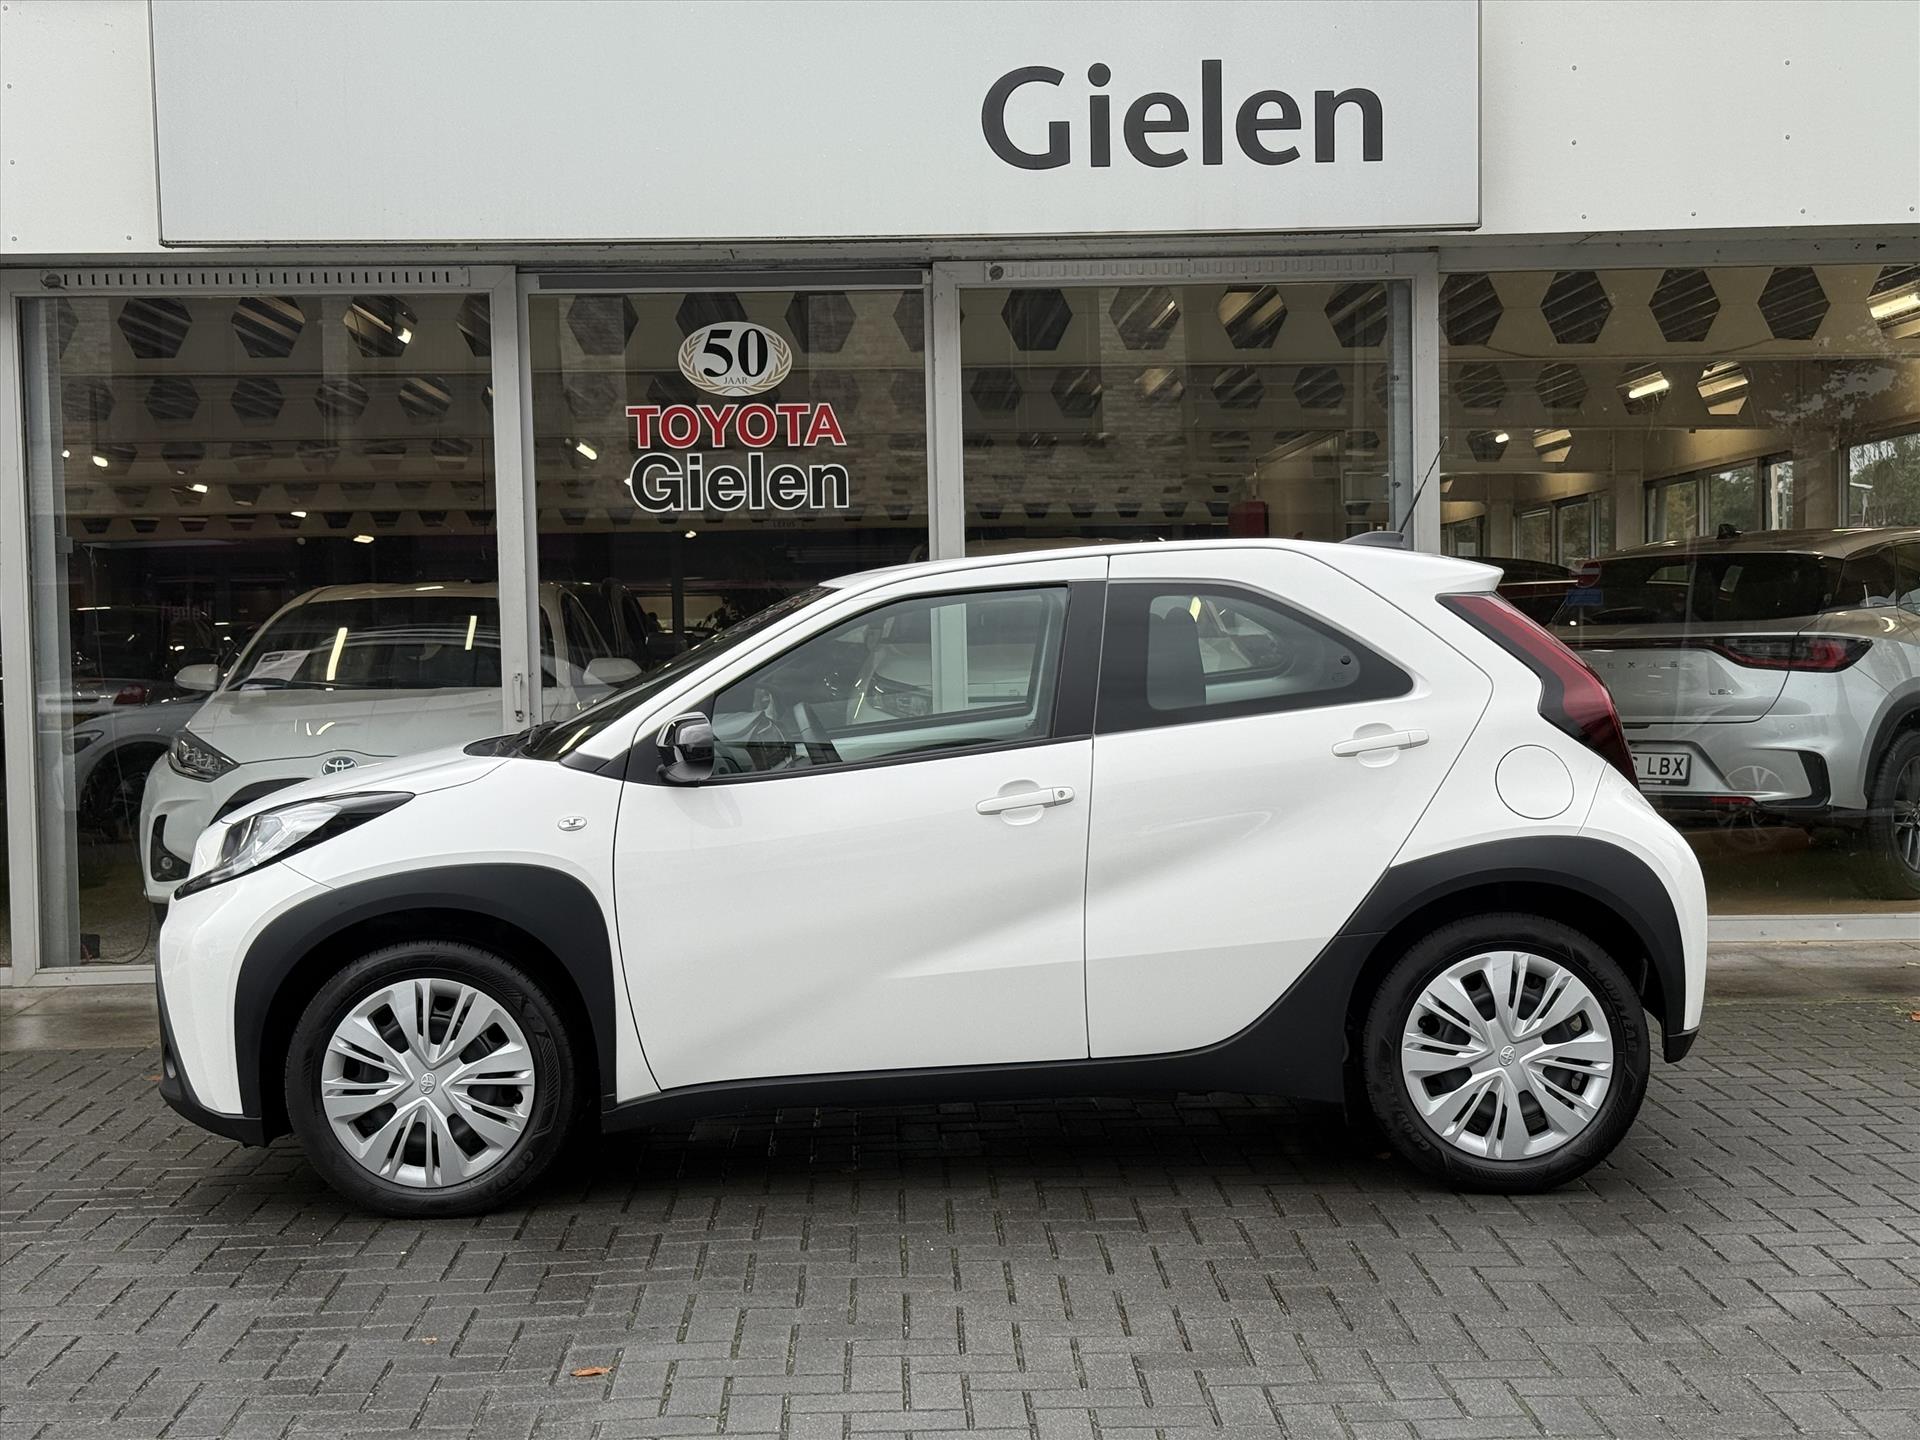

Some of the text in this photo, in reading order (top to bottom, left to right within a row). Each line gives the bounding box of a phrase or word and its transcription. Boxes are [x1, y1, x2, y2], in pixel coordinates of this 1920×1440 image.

[981, 59, 1384, 171] Gielen
[702, 328, 769, 378] 50
[723, 376, 749, 385] JAAR
[625, 402, 848, 449] TOYOTA
[629, 451, 850, 513] Gielen
[1647, 757, 1685, 777] LBX
